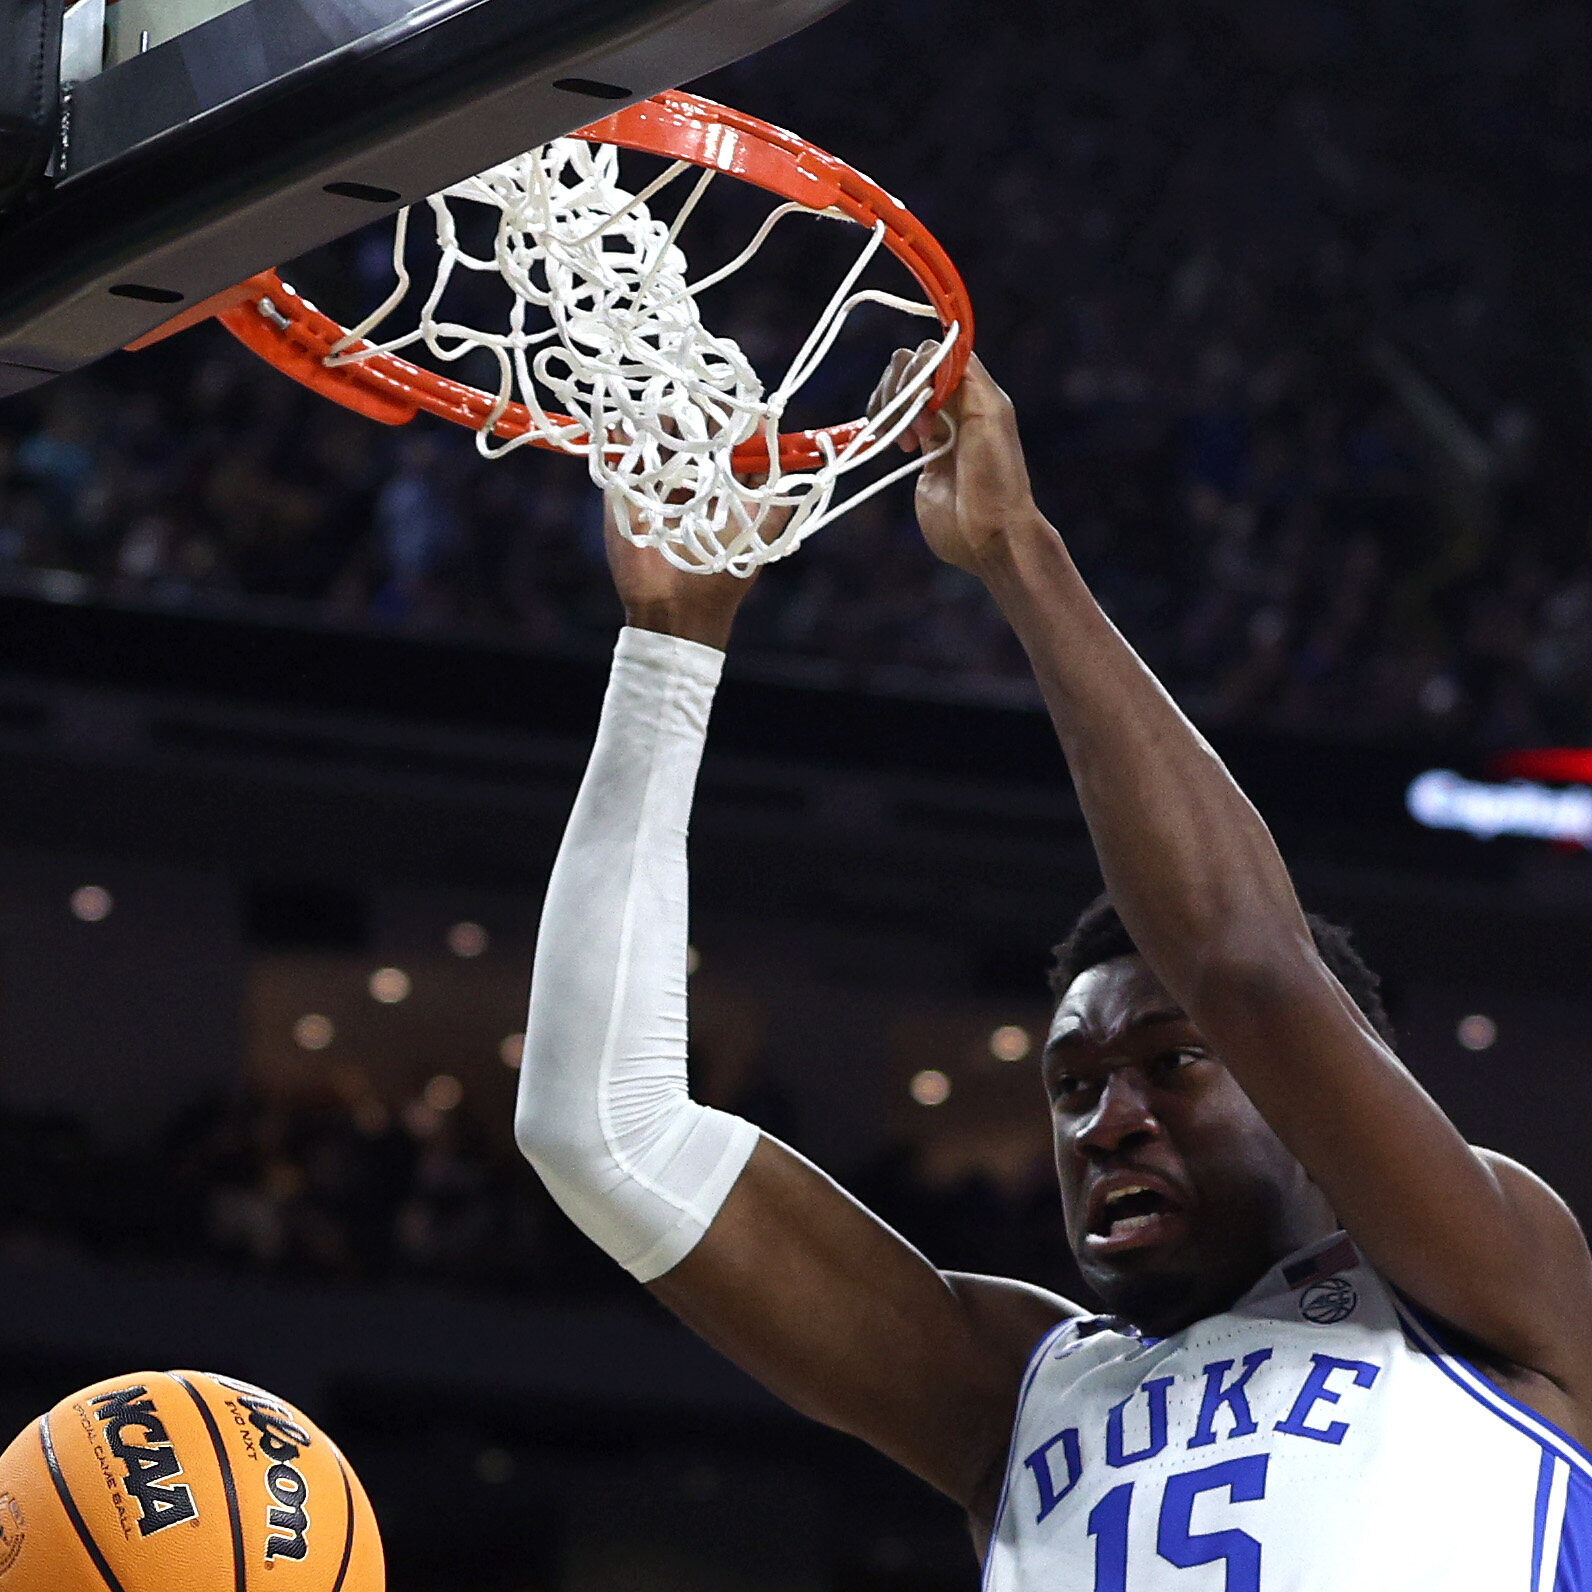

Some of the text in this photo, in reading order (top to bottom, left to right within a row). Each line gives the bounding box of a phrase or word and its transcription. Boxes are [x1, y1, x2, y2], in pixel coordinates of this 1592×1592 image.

[86, 1384, 200, 1540] NCAA
[225, 1401, 258, 1460] EVO NXT
[1024, 1347, 1381, 1524] DUKE
[112, 1493, 134, 1541] BALL
